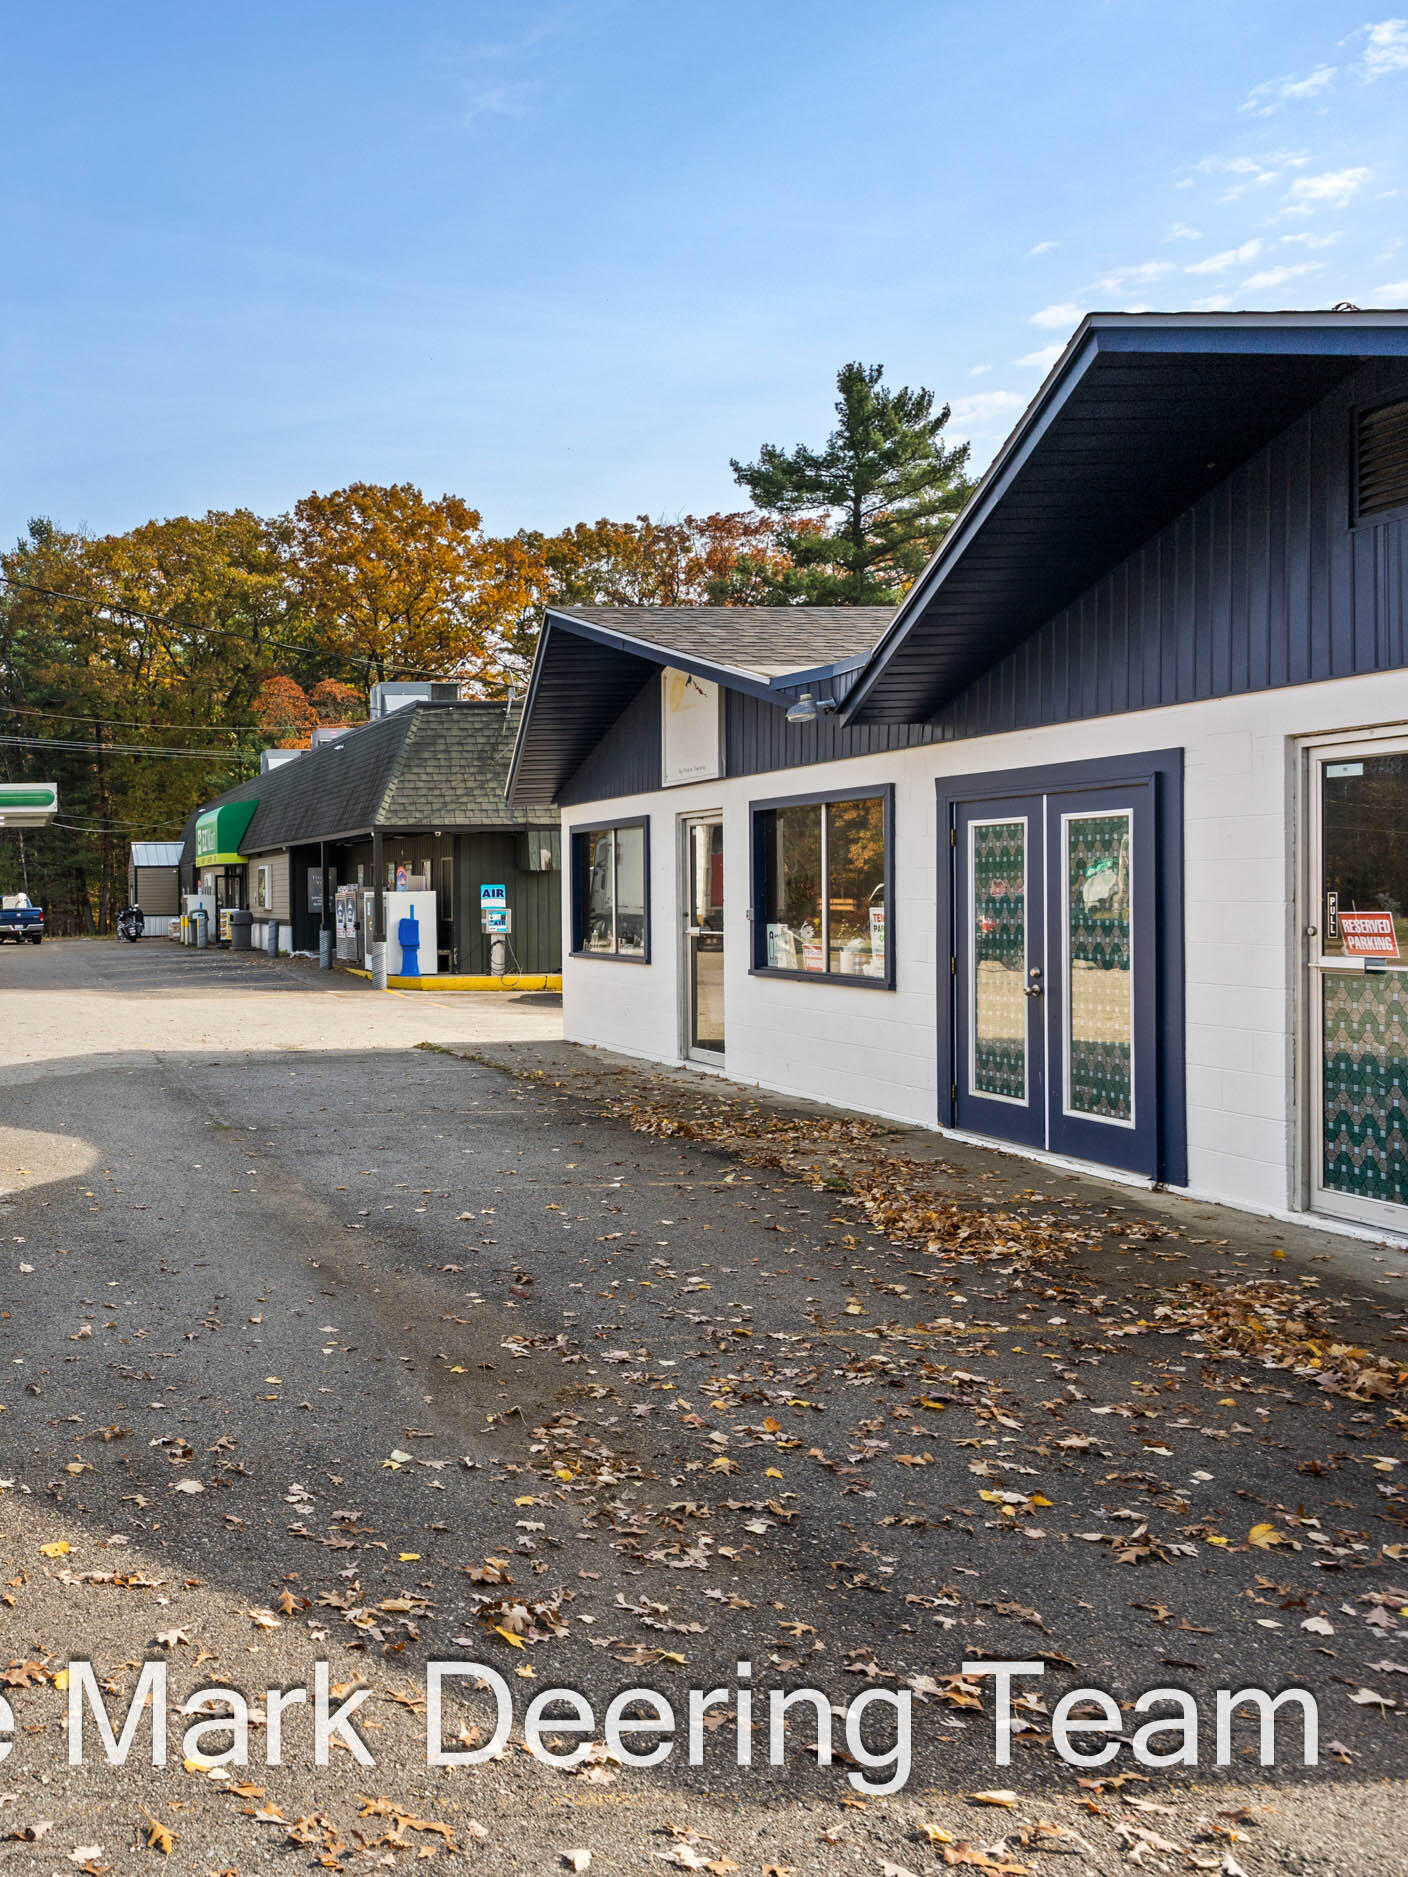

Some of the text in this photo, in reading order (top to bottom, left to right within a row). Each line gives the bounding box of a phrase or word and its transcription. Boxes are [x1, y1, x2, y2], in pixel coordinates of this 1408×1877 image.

[483, 889, 504, 897] AIR
[1341, 919, 1391, 934] RESERVED
[1347, 935, 1394, 951] PARKING
